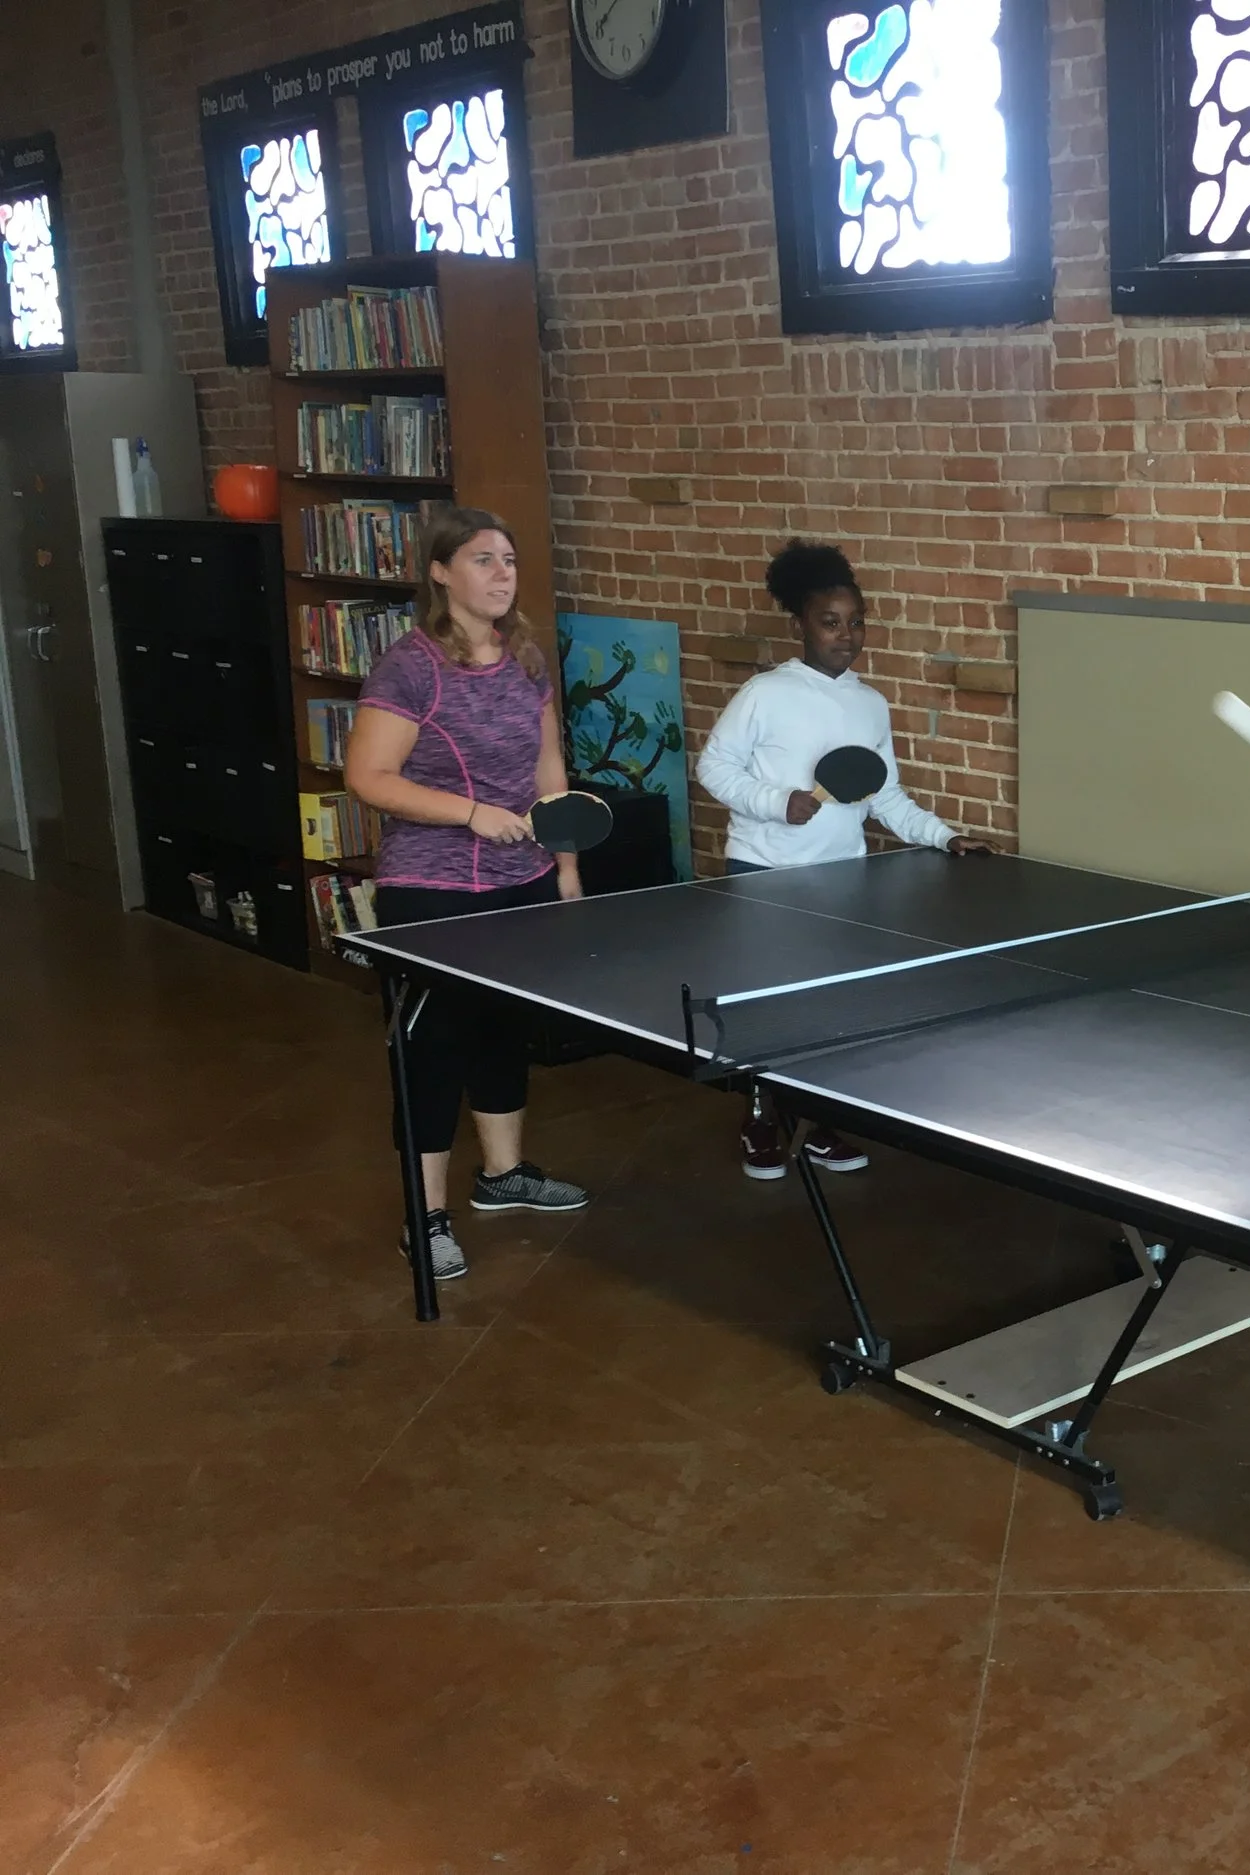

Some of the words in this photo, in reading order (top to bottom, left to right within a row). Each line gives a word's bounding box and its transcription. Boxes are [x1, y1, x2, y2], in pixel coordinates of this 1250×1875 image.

[202, 97, 218, 117] the
[221, 89, 248, 112] Lord,
[306, 68, 322, 93] to
[327, 55, 378, 94] prosper
[385, 49, 411, 81] you
[420, 33, 445, 64] not
[450, 28, 468, 55] to
[473, 20, 515, 49] harm
